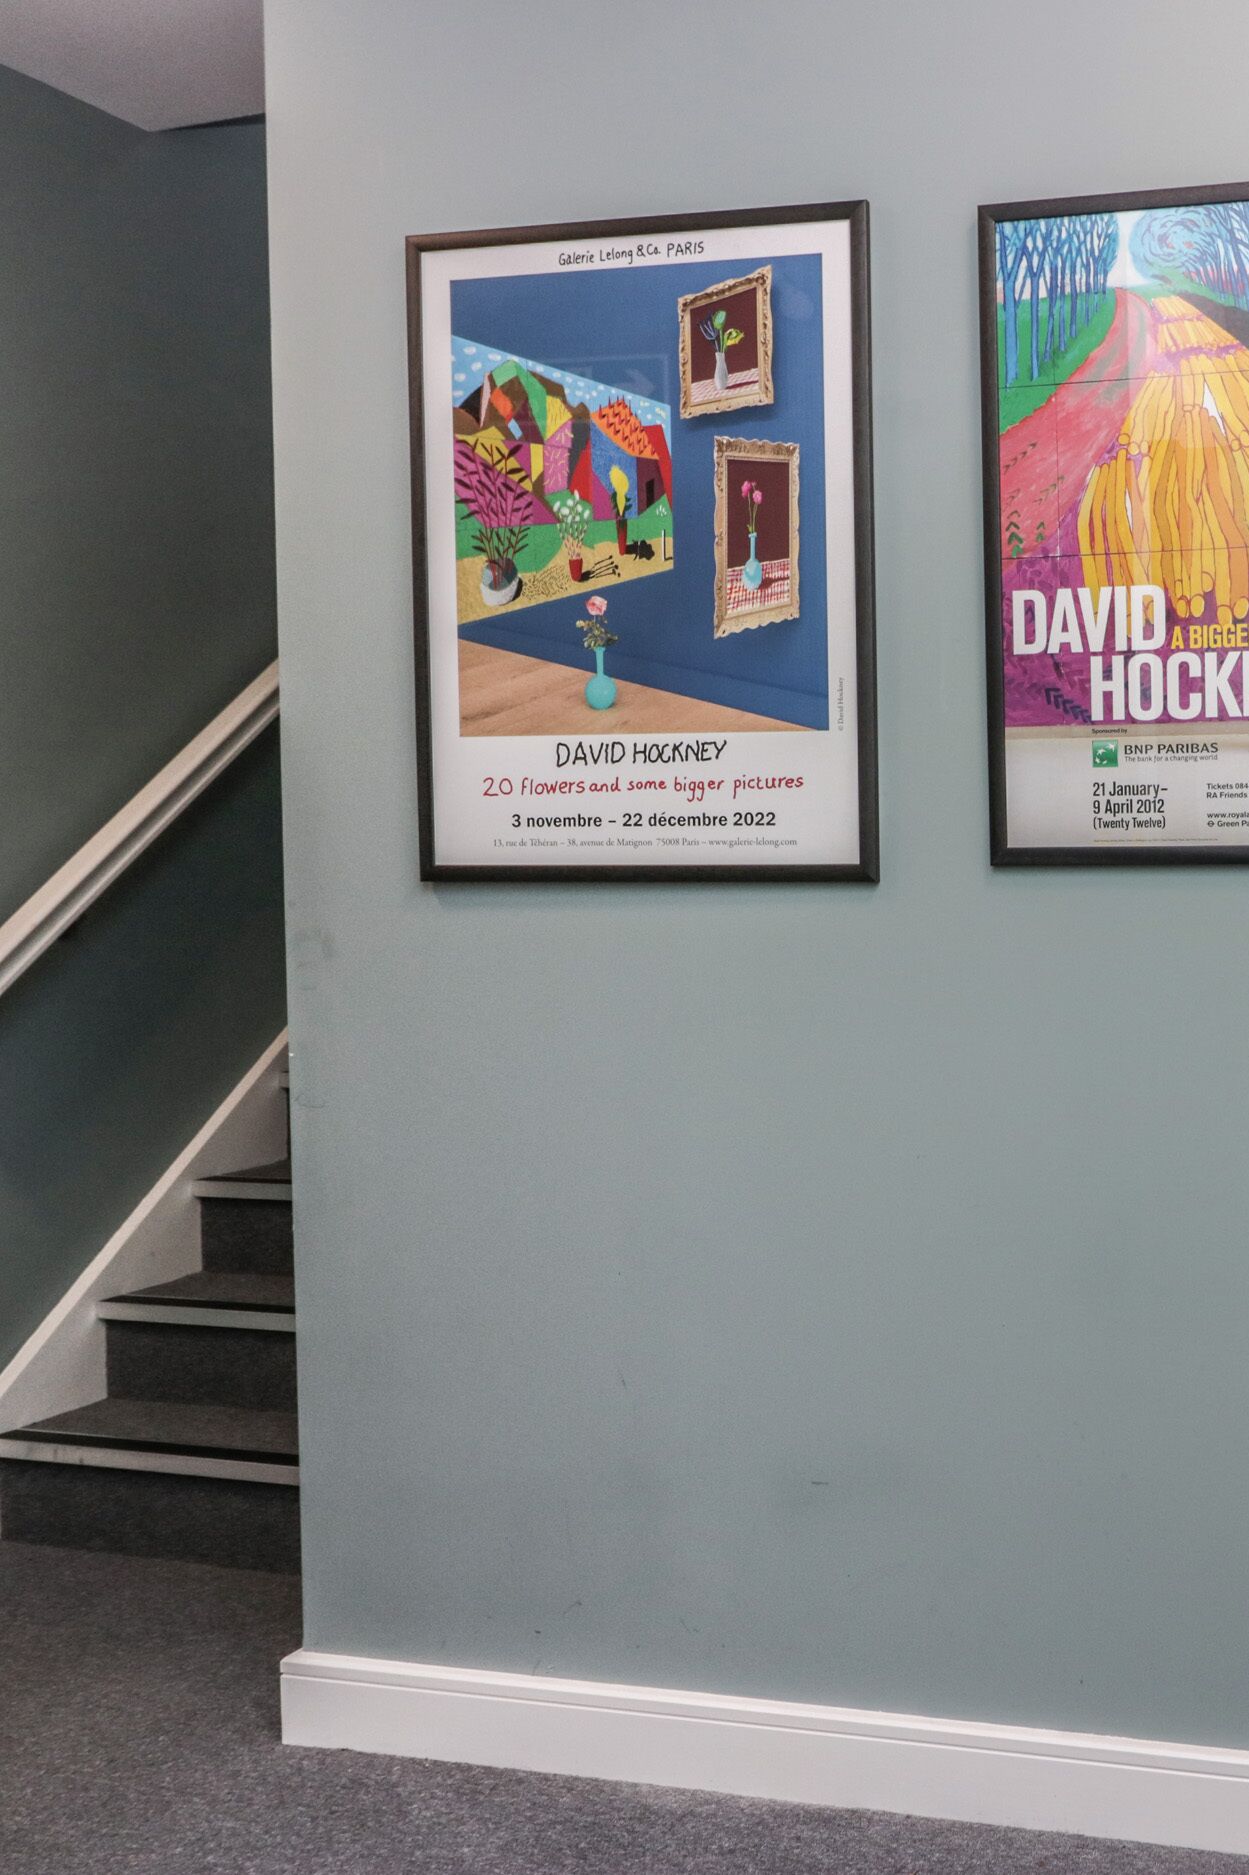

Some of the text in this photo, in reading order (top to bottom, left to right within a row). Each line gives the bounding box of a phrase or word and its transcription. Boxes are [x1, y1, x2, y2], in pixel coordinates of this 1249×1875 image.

[558, 251, 595, 266] Galerie
[599, 248, 633, 265] Lelong
[667, 241, 705, 258] PARIS
[1012, 584, 1167, 655] DAVID
[1171, 632, 1183, 650] A
[556, 740, 727, 768] DAVID HOCKNEY
[1124, 742, 1218, 755] BNP PARIBAS
[1153, 755, 1163, 764] for
[1169, 755, 1198, 763] changing
[483, 774, 804, 803] 20 flowers and some bigger pictures
[1092, 782, 1105, 796] 21
[1092, 799, 1165, 817] 9 April 2012
[511, 814, 521, 828] 3
[526, 813, 602, 828] novembre
[622, 813, 643, 827] 22
[648, 811, 728, 827] décembre
[733, 811, 776, 826] 2022
[1093, 816, 1166, 830] (Twenty Twelve)
[1217, 820, 1240, 828] Green
[493, 839, 504, 848] 13,
[518, 839, 528, 847] de
[567, 839, 577, 847] 38,
[579, 839, 604, 847] avenue
[605, 838, 615, 846] de
[616, 838, 653, 848] Matignon
[656, 837, 680, 846] 75008
[682, 837, 700, 846] Paris
[708, 836, 798, 848] www.galerie-lelong.com
